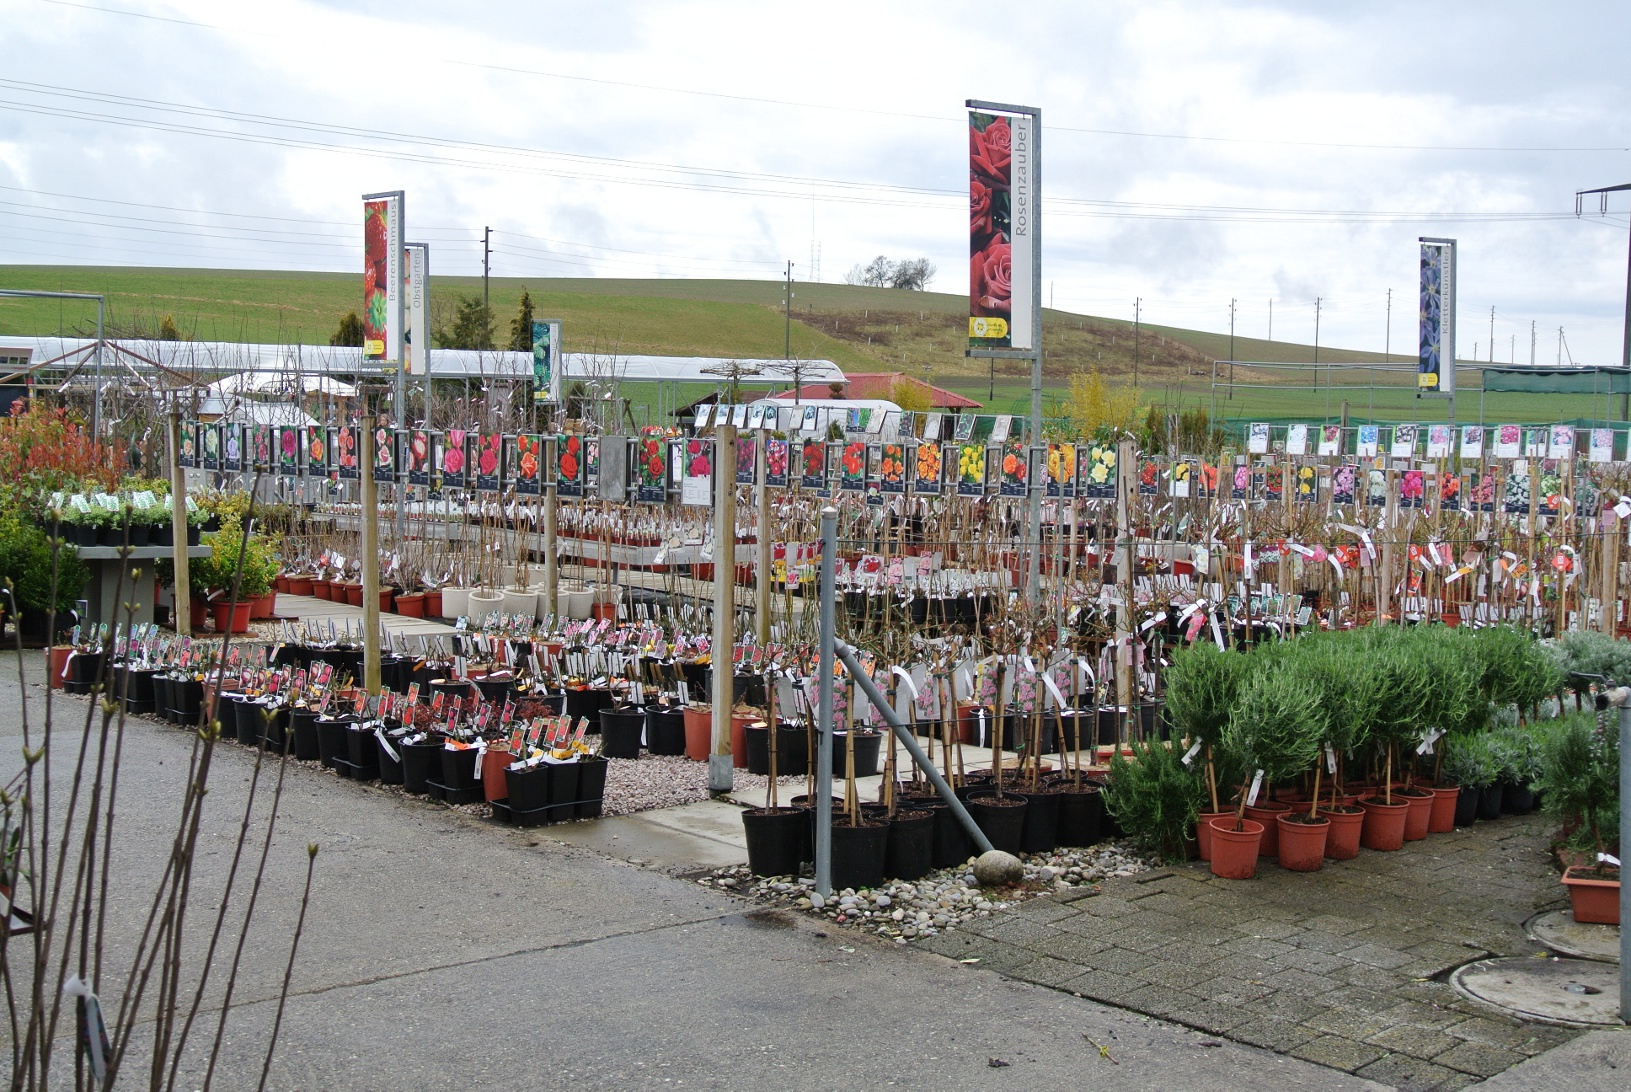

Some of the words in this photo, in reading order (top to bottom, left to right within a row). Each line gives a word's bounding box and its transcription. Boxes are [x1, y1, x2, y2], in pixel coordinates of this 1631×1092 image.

[1015, 124, 1026, 236] Rosenzauber
[389, 204, 397, 301] Beerenschmaus
[413, 253, 422, 308] Obstgarten
